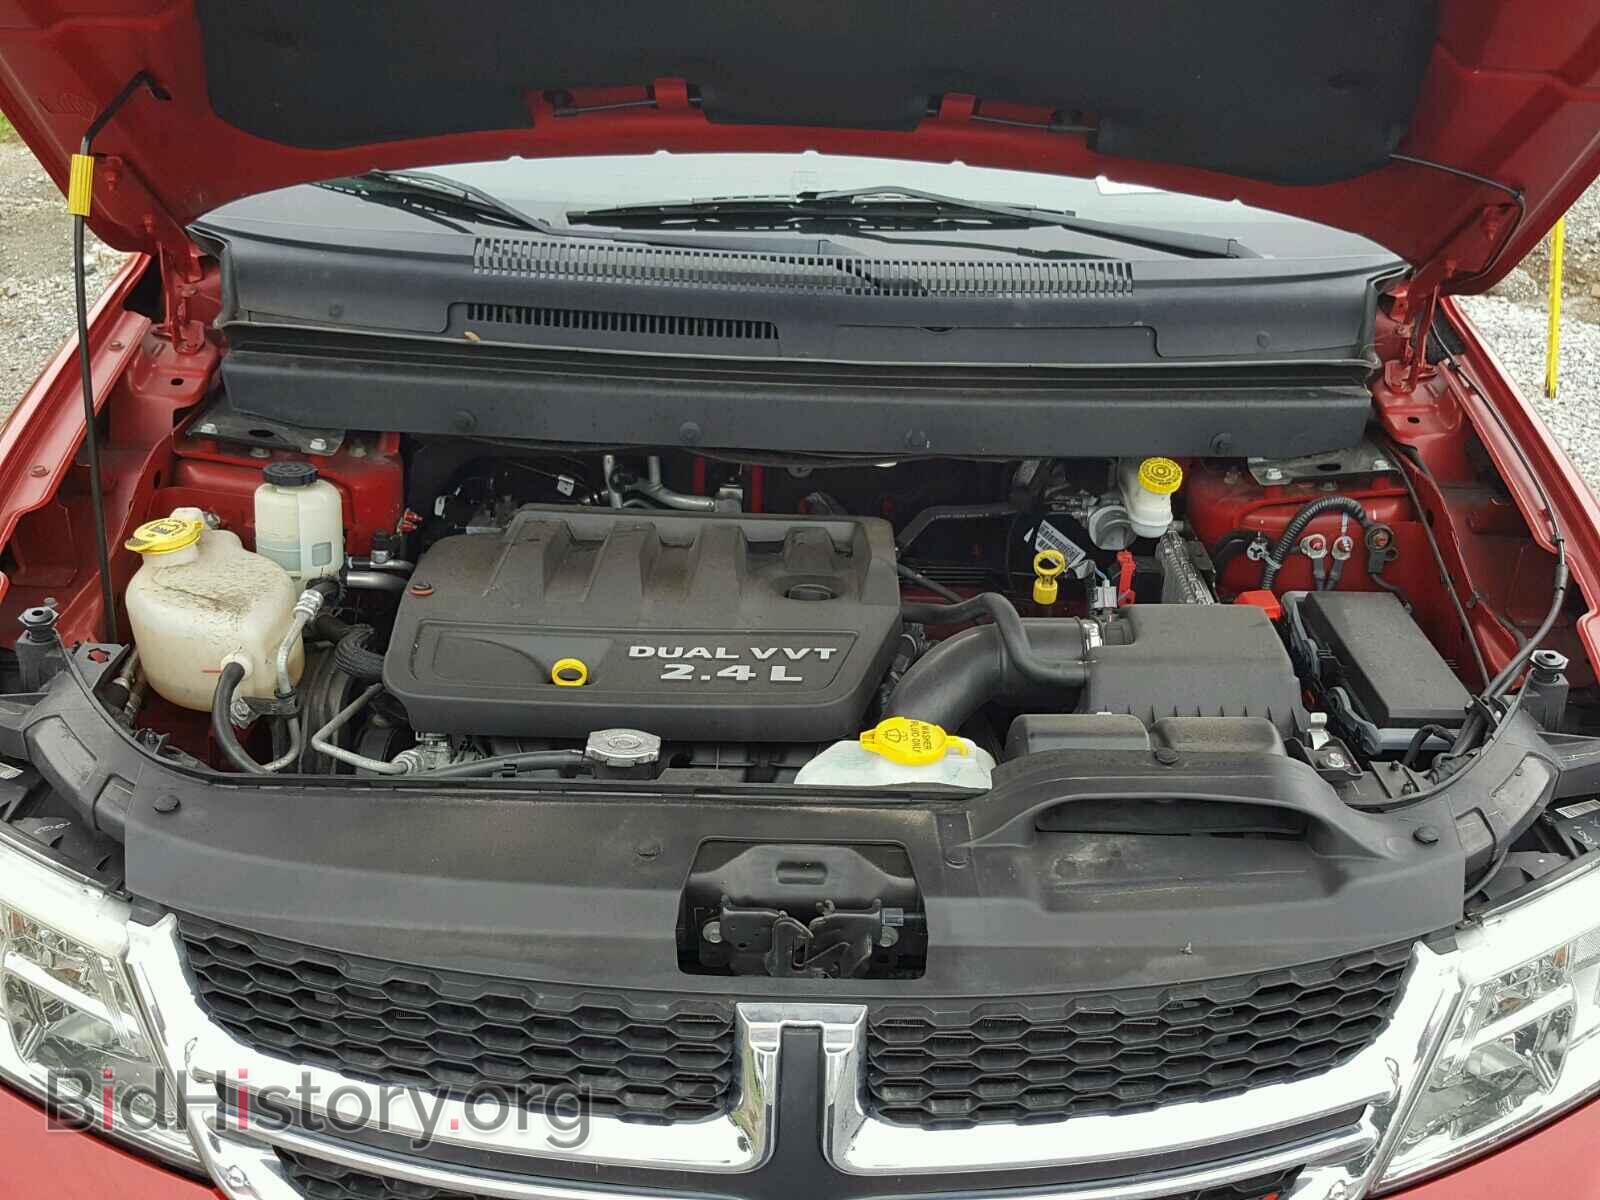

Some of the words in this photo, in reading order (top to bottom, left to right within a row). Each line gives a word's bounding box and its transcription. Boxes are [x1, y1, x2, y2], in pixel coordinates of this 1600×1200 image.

[629, 646, 740, 659] DUAL
[750, 647, 838, 659] VVT
[921, 725, 932, 750] WASHER
